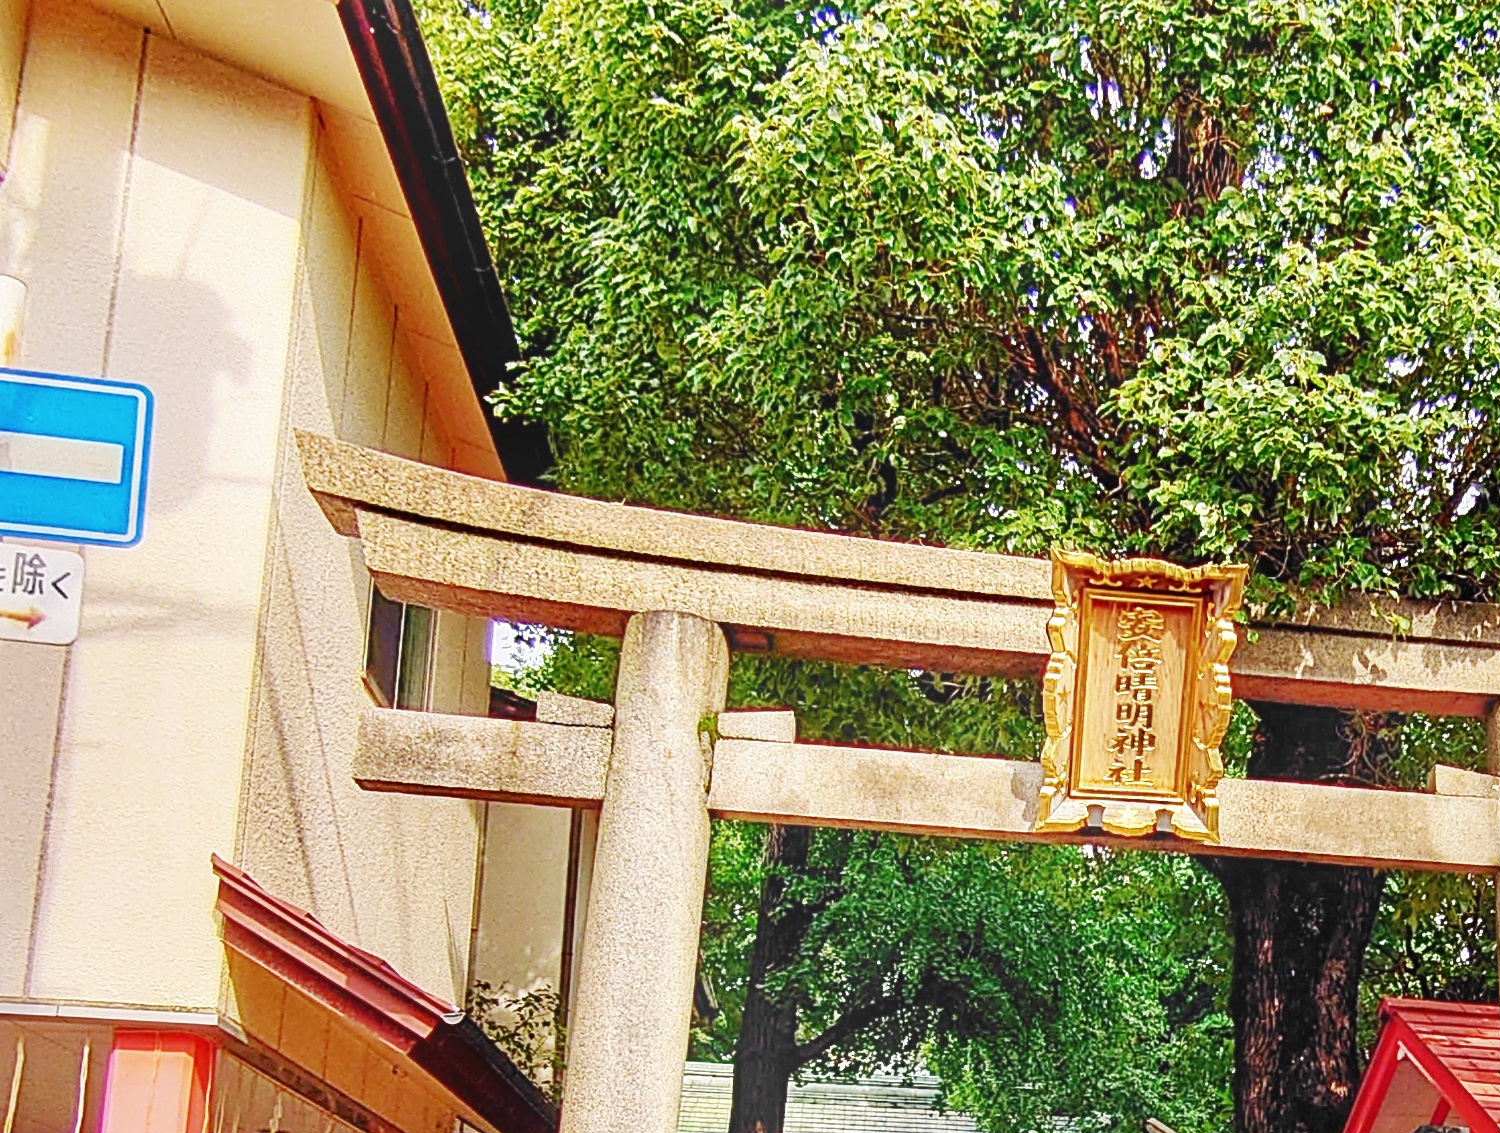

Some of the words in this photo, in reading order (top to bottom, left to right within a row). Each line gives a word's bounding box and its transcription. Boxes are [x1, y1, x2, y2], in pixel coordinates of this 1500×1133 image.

[1104, 606, 1165, 786] 安倍晴明神社
